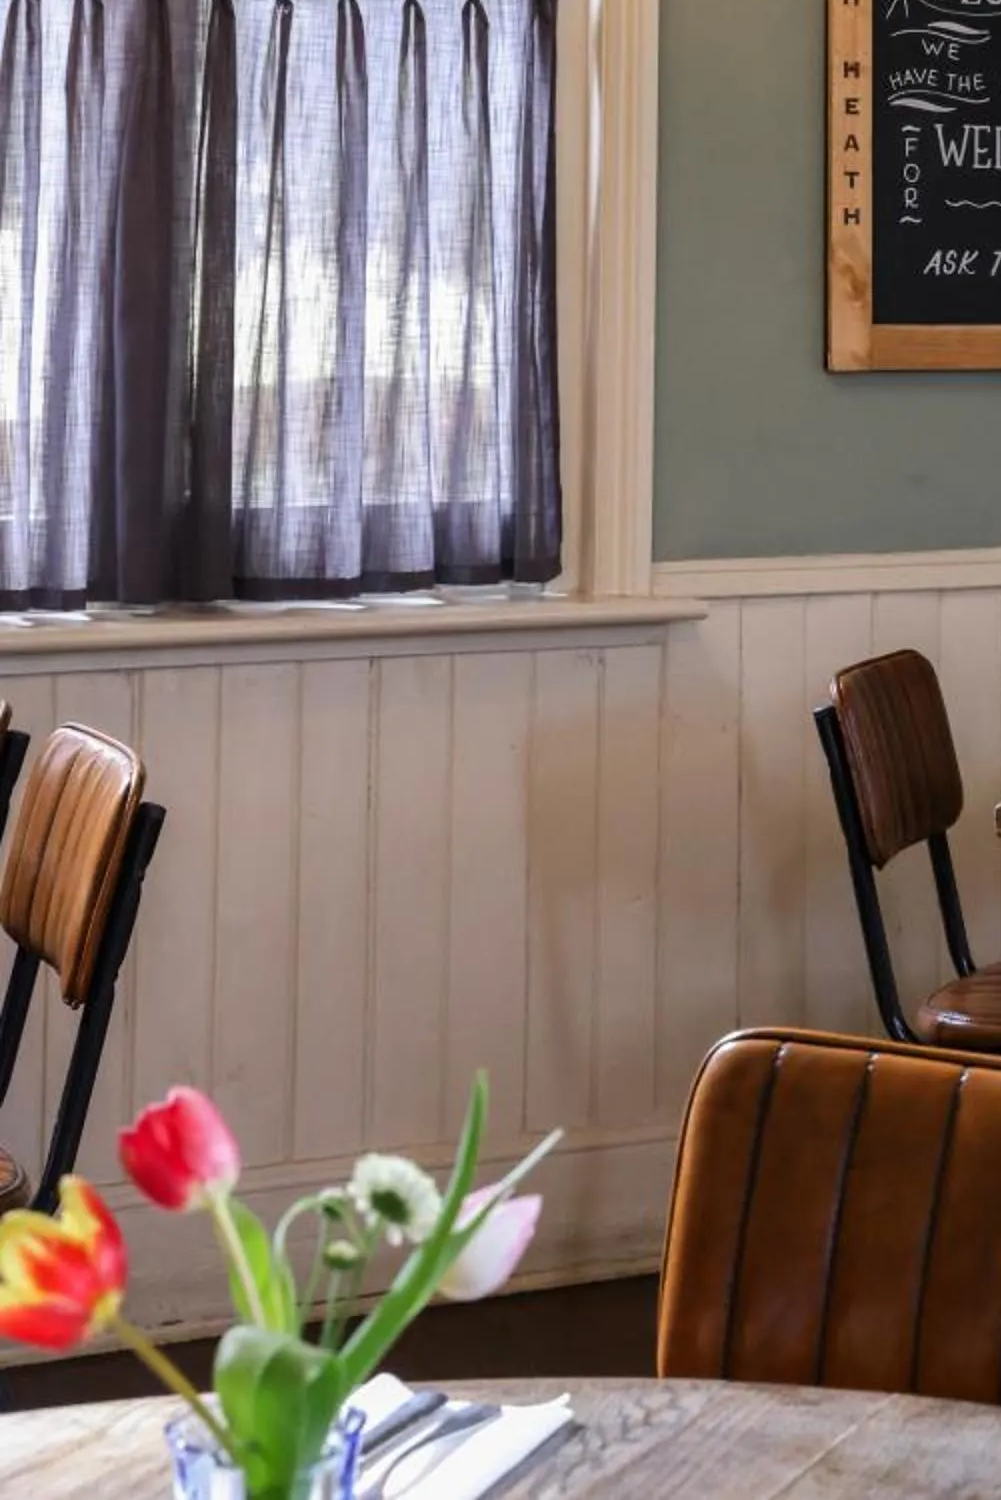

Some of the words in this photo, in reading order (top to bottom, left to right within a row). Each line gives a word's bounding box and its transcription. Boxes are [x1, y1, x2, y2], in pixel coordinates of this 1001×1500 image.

[921, 38, 961, 61] WE
[888, 67, 938, 90] HAVE
[946, 72, 987, 92] THE
[842, 60, 861, 225] HEATH
[903, 137, 921, 209] FOR
[923, 249, 980, 276] ASK
